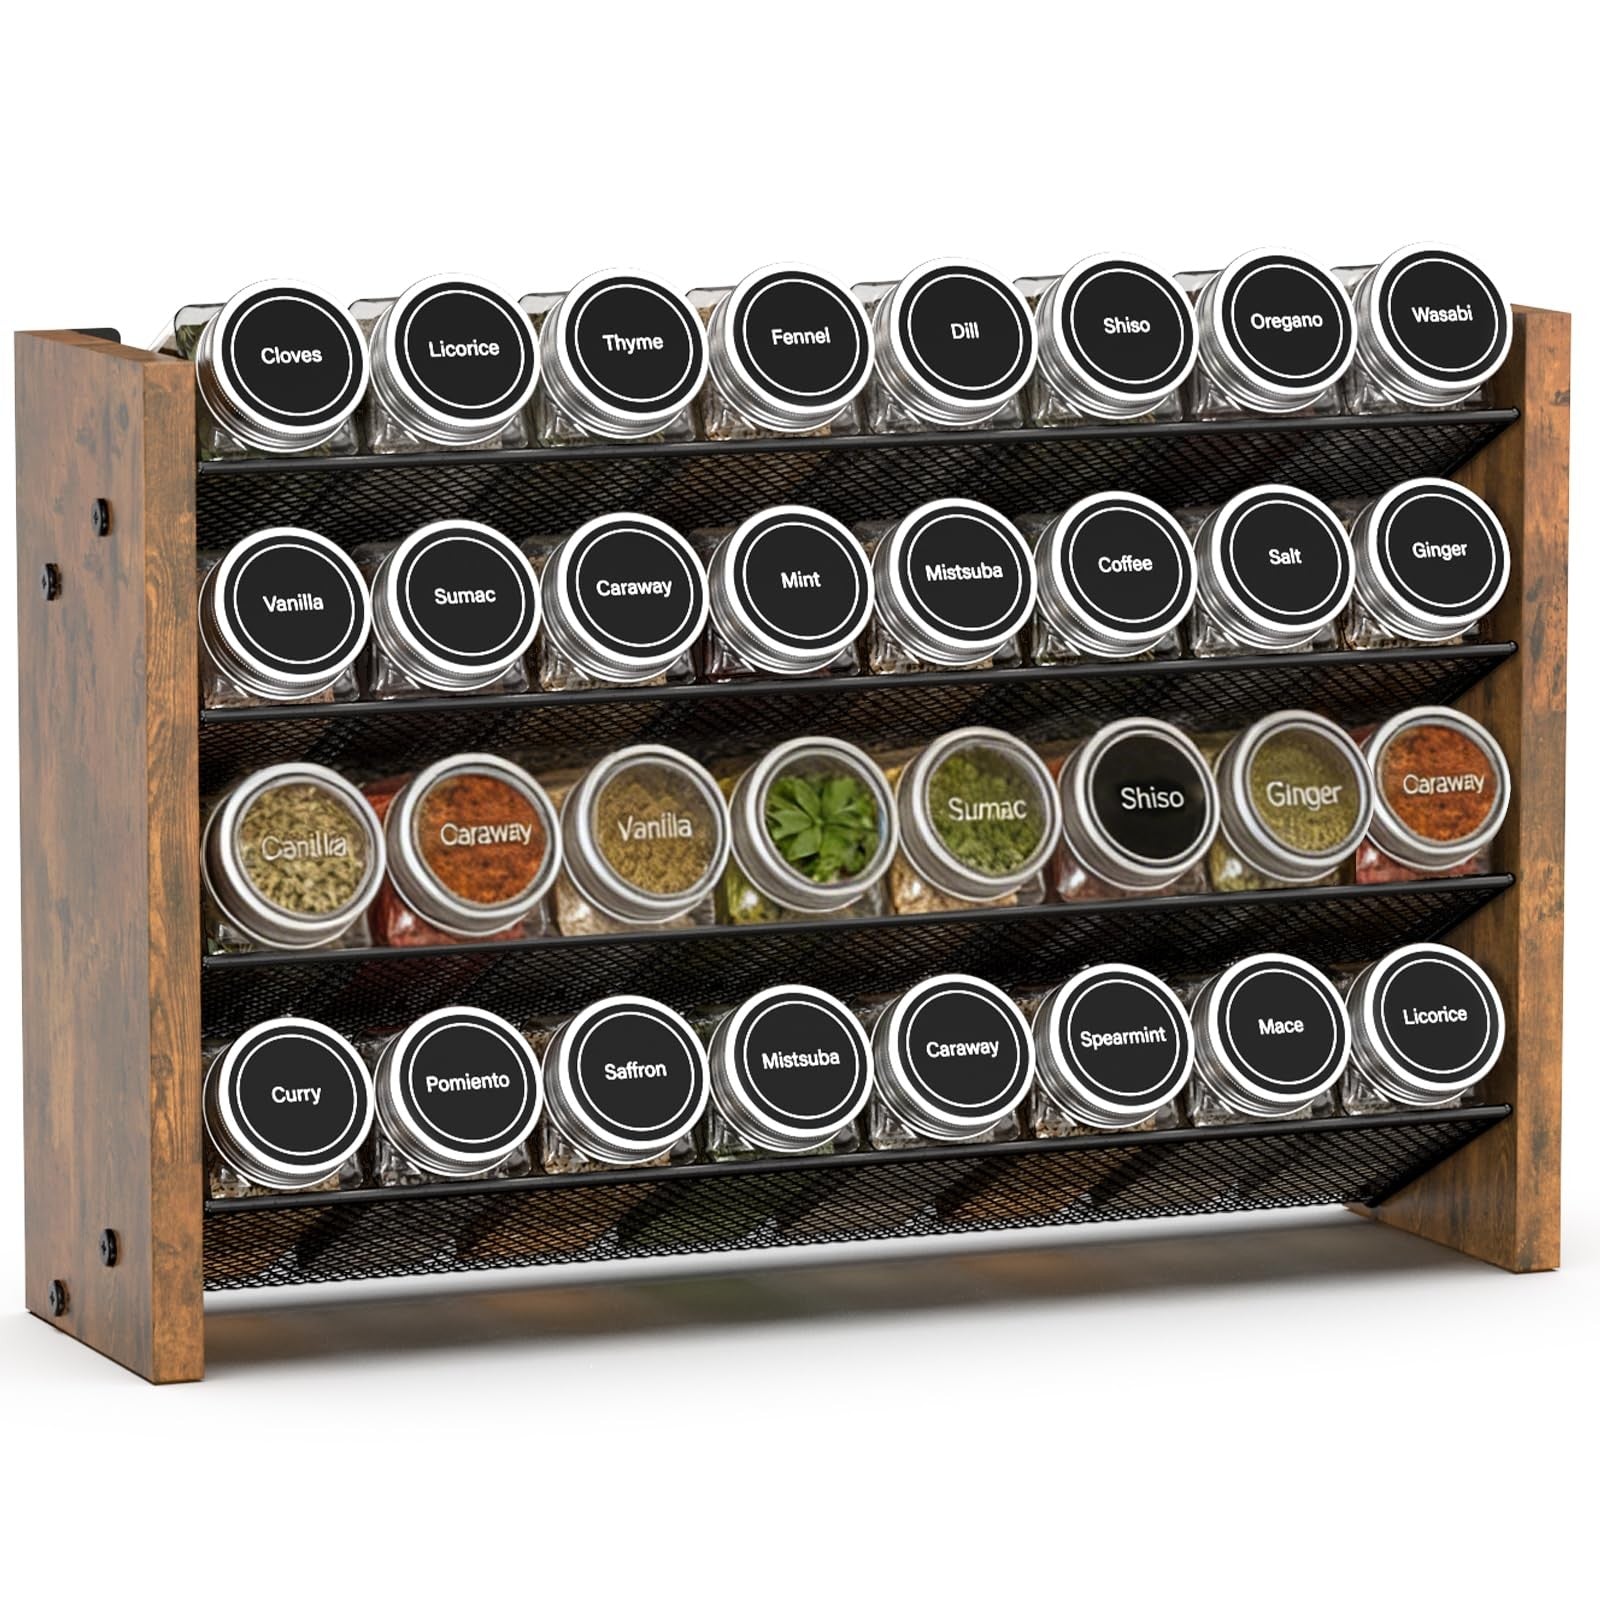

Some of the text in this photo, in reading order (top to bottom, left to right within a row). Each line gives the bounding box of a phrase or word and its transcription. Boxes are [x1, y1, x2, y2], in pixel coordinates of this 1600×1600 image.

[1251, 313, 1323, 332] Oregano
[1412, 304, 1473, 322] Wasabi
[951, 322, 979, 339] Dill
[1104, 316, 1150, 334] Shiso
[602, 334, 663, 354] Thyme
[771, 327, 830, 345] Fennel
[261, 347, 322, 364] Cloves
[429, 339, 499, 357] Licorice
[1269, 548, 1302, 565] Salt
[1412, 542, 1467, 561] Ginger
[925, 562, 1003, 581] Mistsuba
[1098, 555, 1152, 573] Coffee
[596, 580, 672, 597] Caraway
[781, 571, 821, 588] Mint
[263, 593, 324, 612] Vanilla
[435, 588, 496, 604] Sumac
[1403, 772, 1484, 795] Caraway
[1120, 784, 1184, 810] Shiso
[1266, 781, 1342, 811] Ginger
[948, 797, 1027, 821] Sumac
[440, 822, 532, 846] Caraway
[1403, 1006, 1467, 1024] Licorice
[1258, 1019, 1304, 1035] Mace
[1081, 1026, 1167, 1050] Spearmint
[762, 1049, 840, 1069] Mistsuba
[927, 1041, 999, 1058] Caraway
[605, 1061, 667, 1080] Saffron
[426, 1073, 510, 1092] Pomiento
[272, 1086, 321, 1105] Curry
